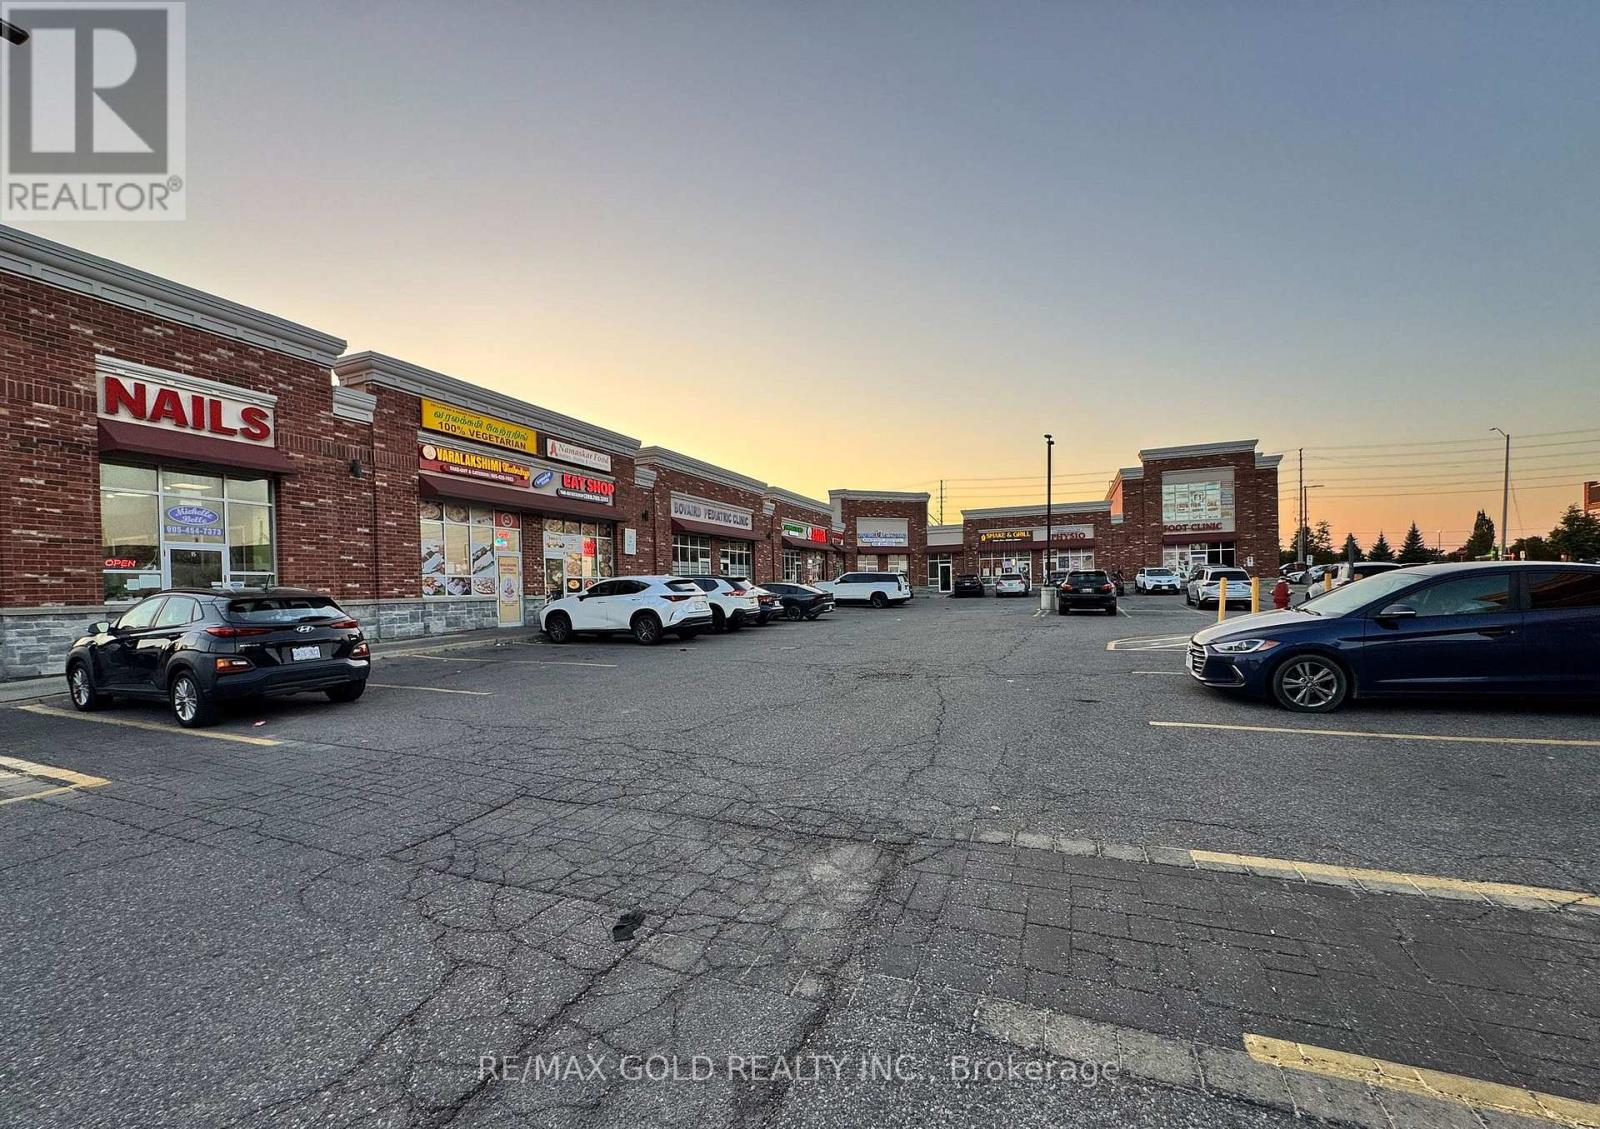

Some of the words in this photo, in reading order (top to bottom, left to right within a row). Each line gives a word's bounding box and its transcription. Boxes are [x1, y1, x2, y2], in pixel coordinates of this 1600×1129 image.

[104, 376, 271, 441] NAILS
[438, 421, 466, 435] 100%
[468, 429, 527, 450] VEGETARIAN
[558, 443, 593, 459] Namaskar
[593, 452, 609, 464] Food
[562, 472, 586, 490] EAT
[586, 479, 615, 495] SHOP
[673, 501, 702, 518] BOVAIRD
[703, 507, 732, 524] PEDIATRIC
[732, 514, 749, 527] CLINIC
[1012, 530, 1031, 538] GRILL
[1051, 532, 1086, 540] PHYSIO
[1163, 523, 1189, 532] FOOT
[1190, 522, 1223, 531] CLINIC
[104, 559, 137, 568] OPEN
